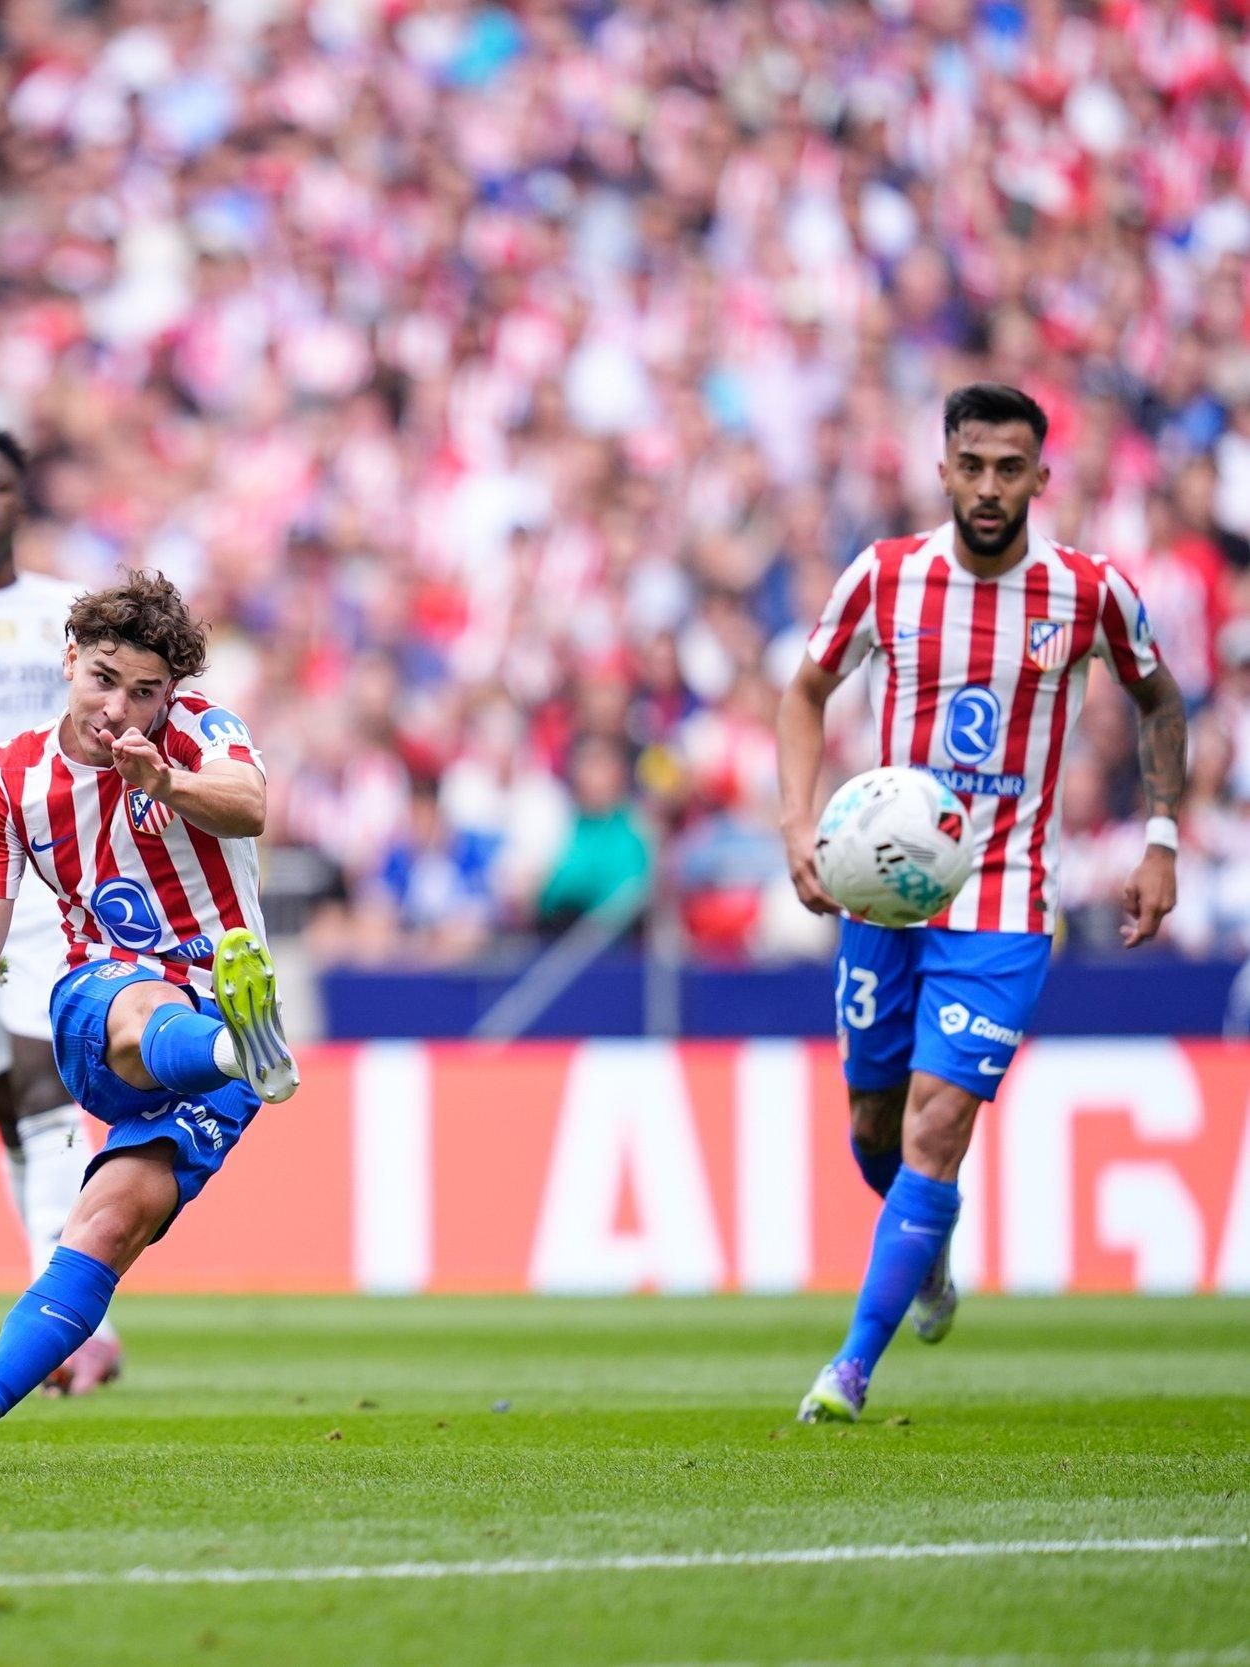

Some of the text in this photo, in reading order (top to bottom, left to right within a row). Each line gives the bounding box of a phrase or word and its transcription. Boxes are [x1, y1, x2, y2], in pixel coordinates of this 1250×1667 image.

[930, 770, 1023, 796] ADH AIR
[176, 938, 211, 959] AIR
